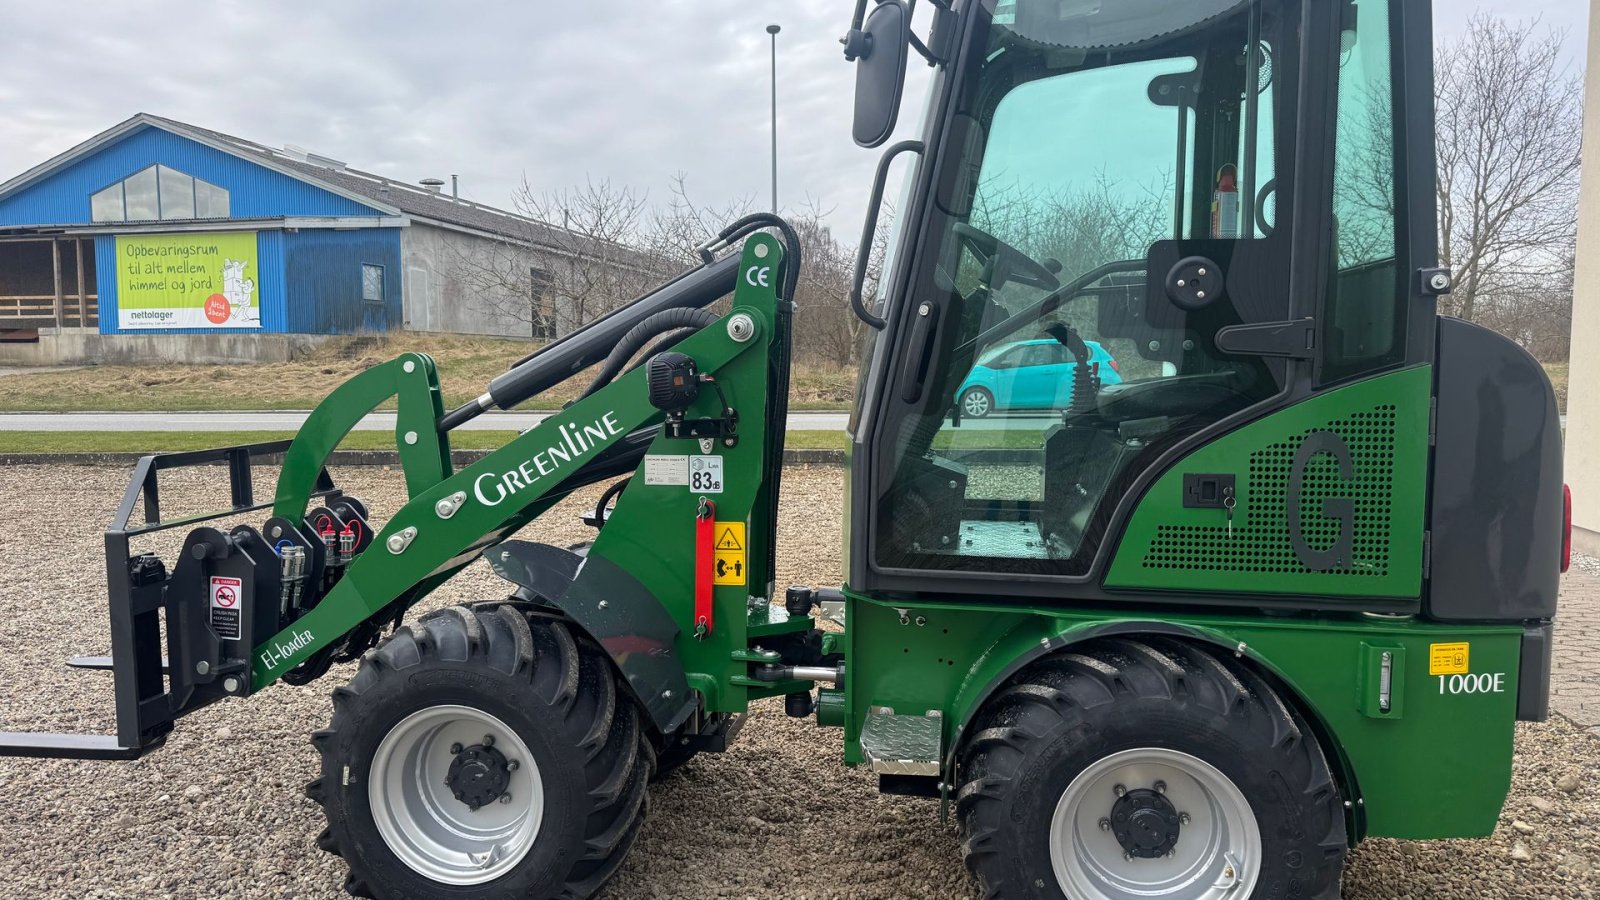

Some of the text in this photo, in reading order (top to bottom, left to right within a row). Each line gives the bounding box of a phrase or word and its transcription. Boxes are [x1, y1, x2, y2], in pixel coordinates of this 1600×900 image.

[126, 242, 219, 259] Opbevaringsrum
[128, 259, 206, 275] til alt mellem
[746, 265, 770, 287] CE
[129, 276, 213, 294] himmel og jord
[131, 310, 174, 321] nettolager
[692, 471, 713, 490] 83
[712, 480, 721, 490] dB
[1287, 430, 1355, 571] G
[1438, 672, 1506, 695] 1000E
